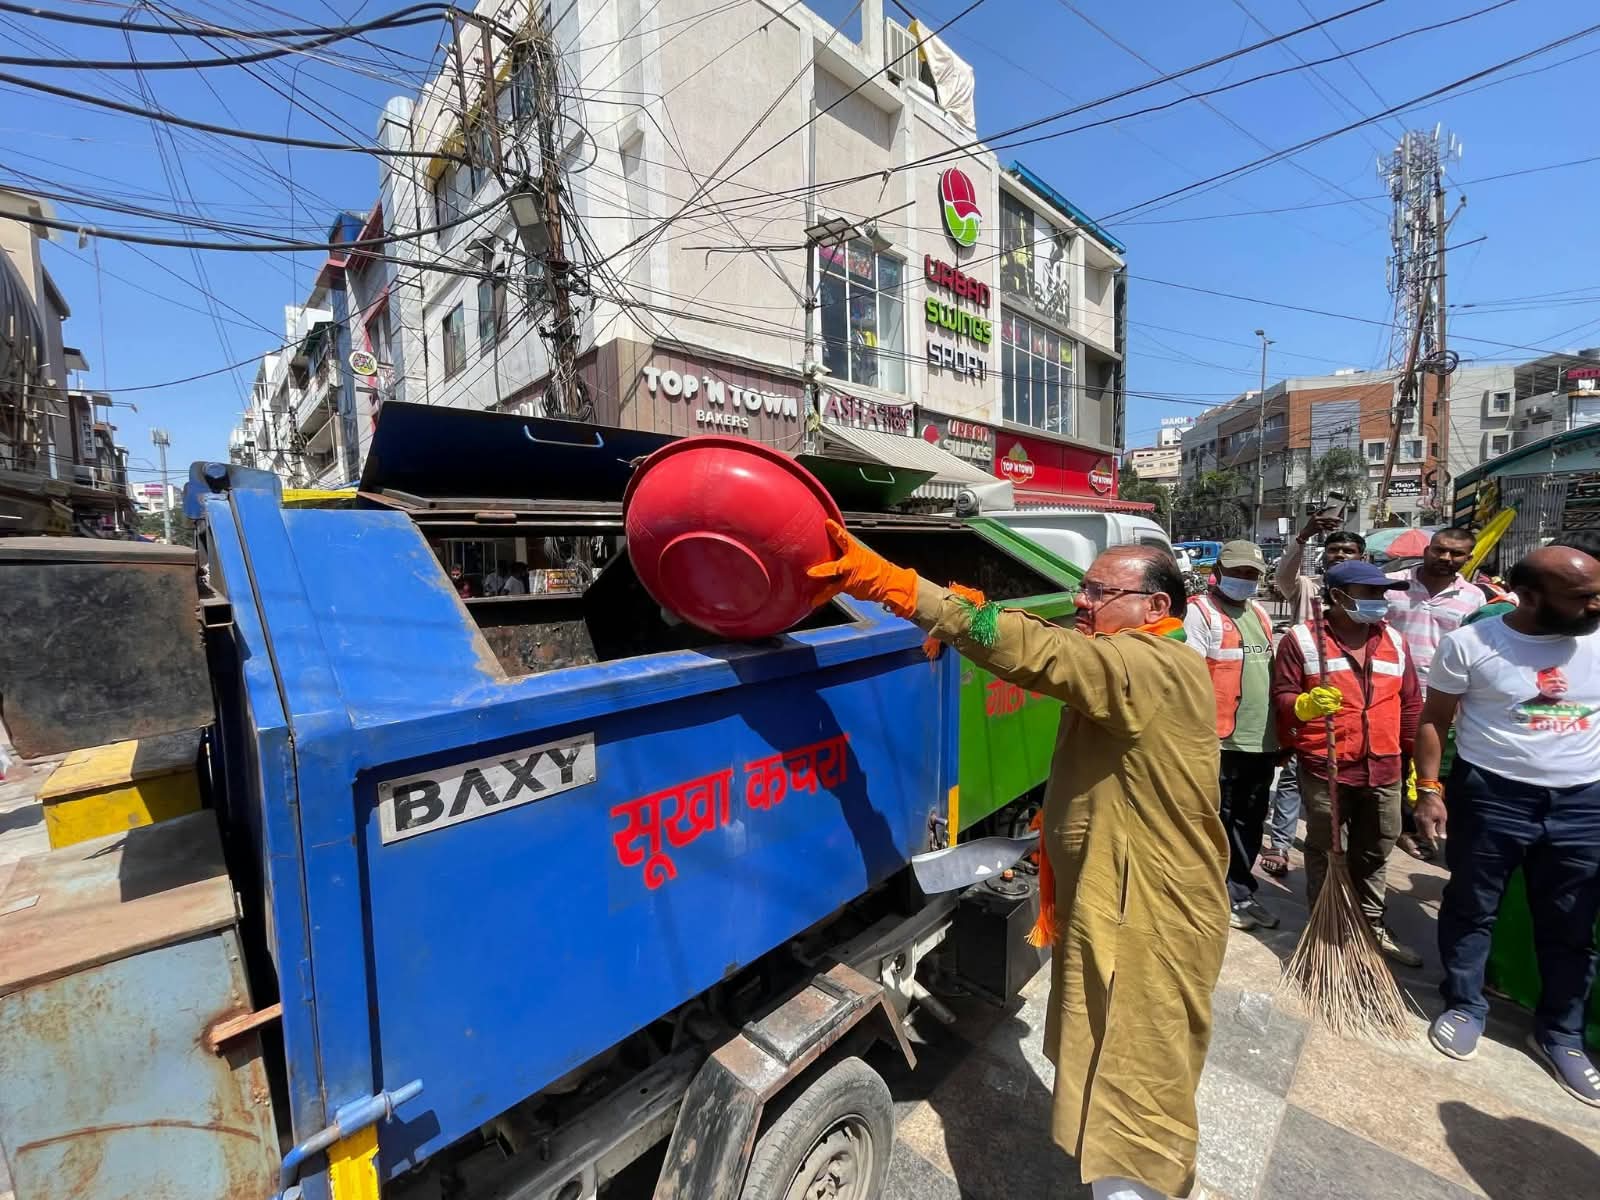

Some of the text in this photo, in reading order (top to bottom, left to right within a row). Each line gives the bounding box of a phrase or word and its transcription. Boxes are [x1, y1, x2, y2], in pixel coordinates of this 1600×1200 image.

[924, 254, 990, 308] URBAN
[925, 297, 993, 346] SWINGS
[927, 339, 987, 382] SPORT
[643, 366, 699, 399] TOP
[728, 383, 798, 418] TOWN
[824, 392, 878, 425] ASHA
[695, 409, 750, 429] BAKERS
[947, 419, 990, 442] URBAN
[1002, 461, 1014, 472] TOP
[1018, 463, 1033, 475] TOWN
[393, 740, 588, 833] BAXY
[609, 732, 852, 891] सूखा कचरा
